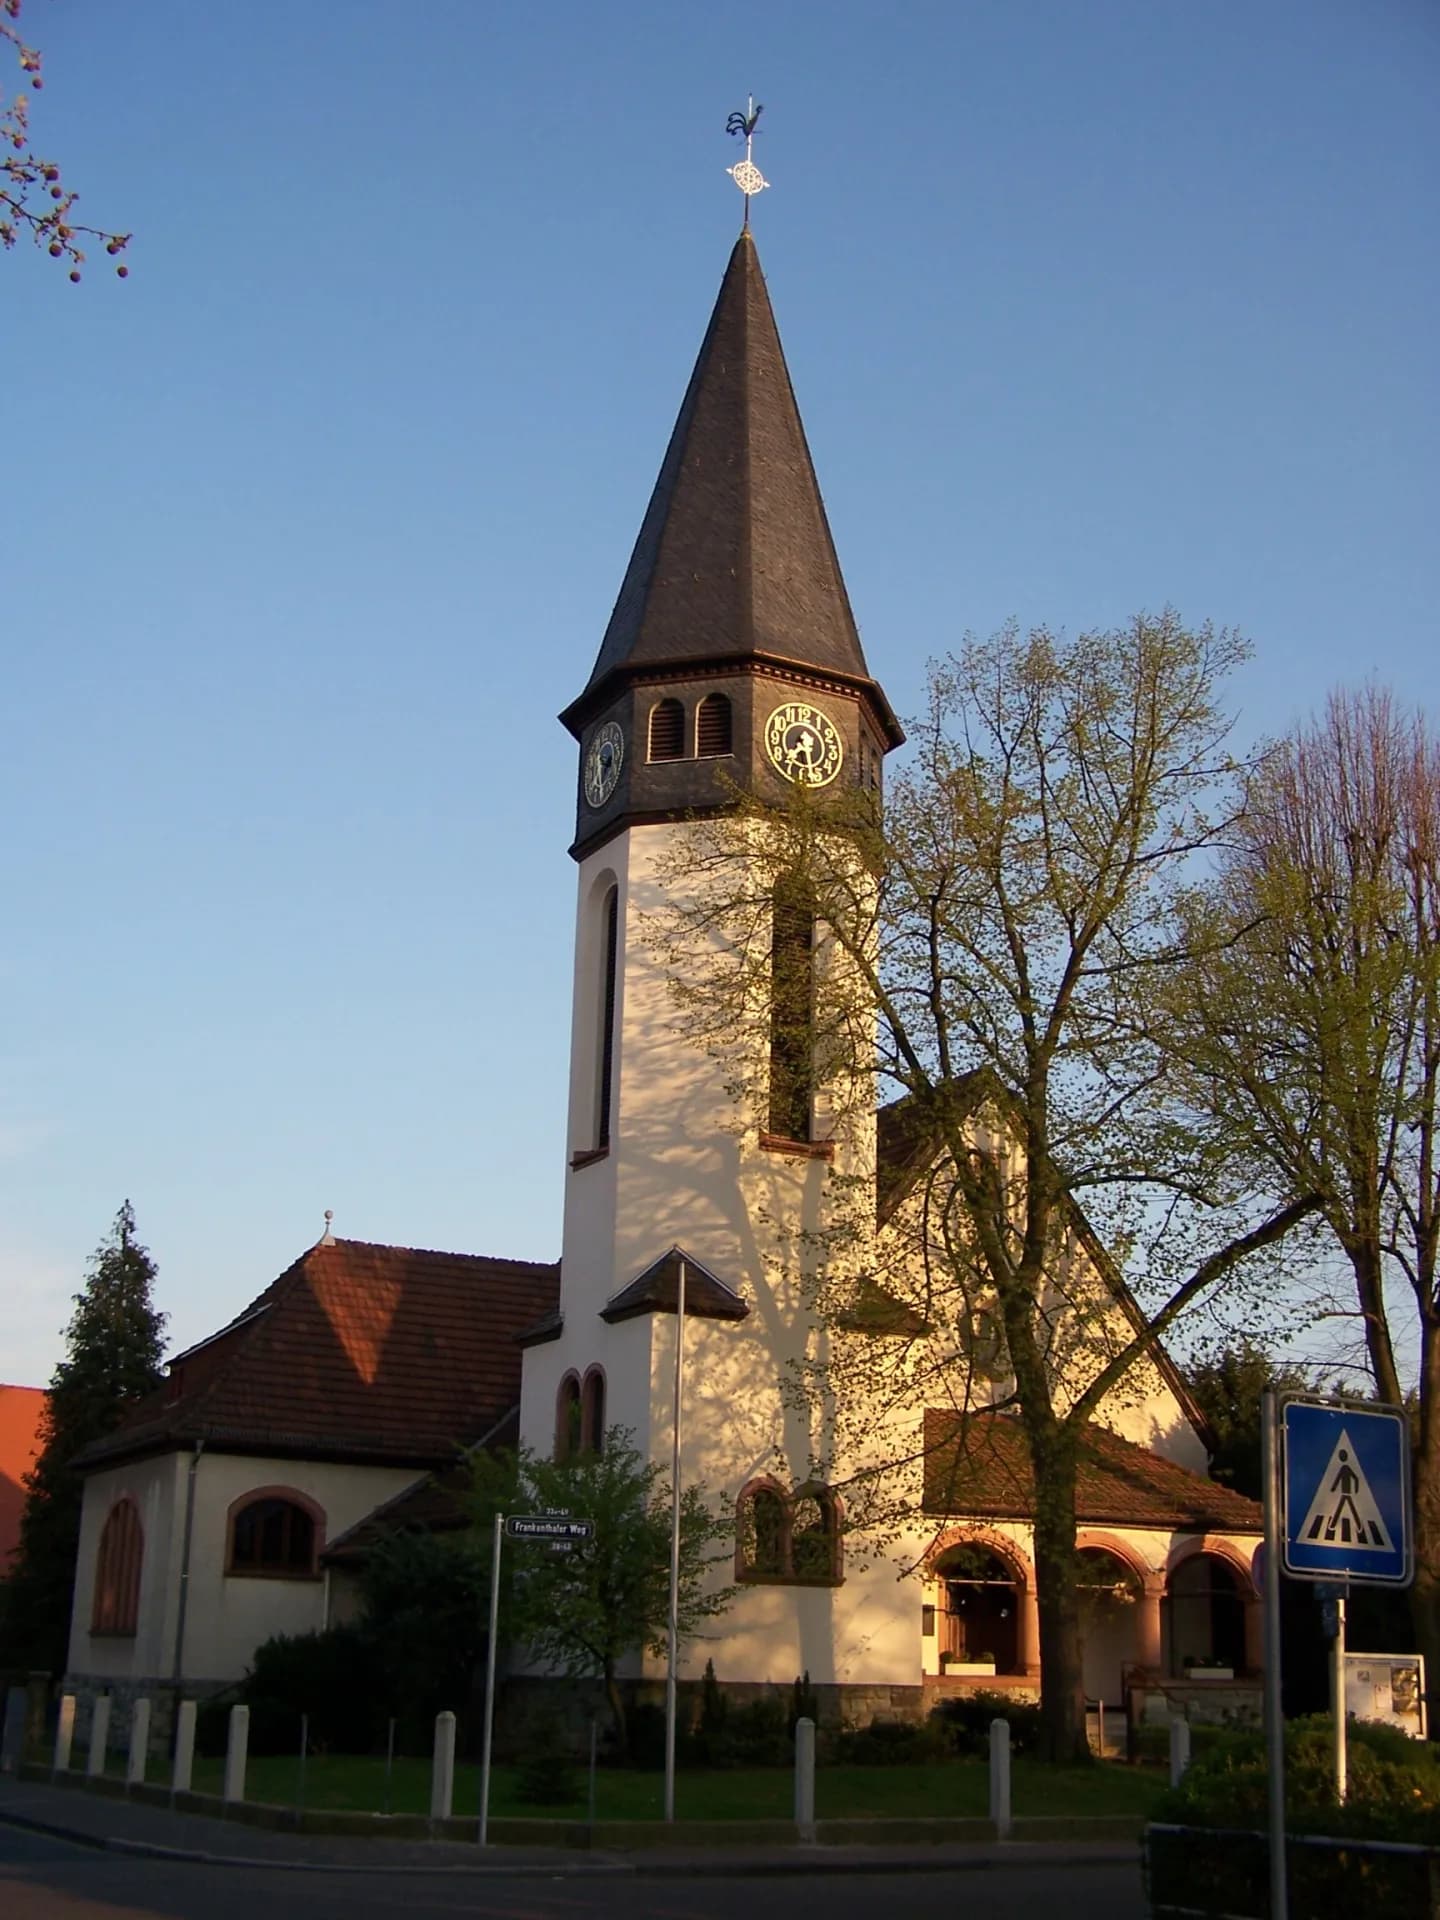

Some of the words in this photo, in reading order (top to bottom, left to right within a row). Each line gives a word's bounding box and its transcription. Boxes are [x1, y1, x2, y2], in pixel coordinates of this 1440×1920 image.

[785, 707, 795, 723] 11
[798, 707, 811, 723] 12
[816, 715, 822, 730] 1
[774, 715, 786, 732] 10
[770, 730, 780, 745] 9
[824, 728, 834, 744] 2
[774, 746, 782, 761] 8
[828, 745, 838, 760] 3
[784, 759, 793, 775] 7
[823, 758, 832, 775] 4
[814, 767, 823, 782] 5
[515, 1521, 567, 1533] Frankenthaler
[569, 1524, 587, 1536] Weg
